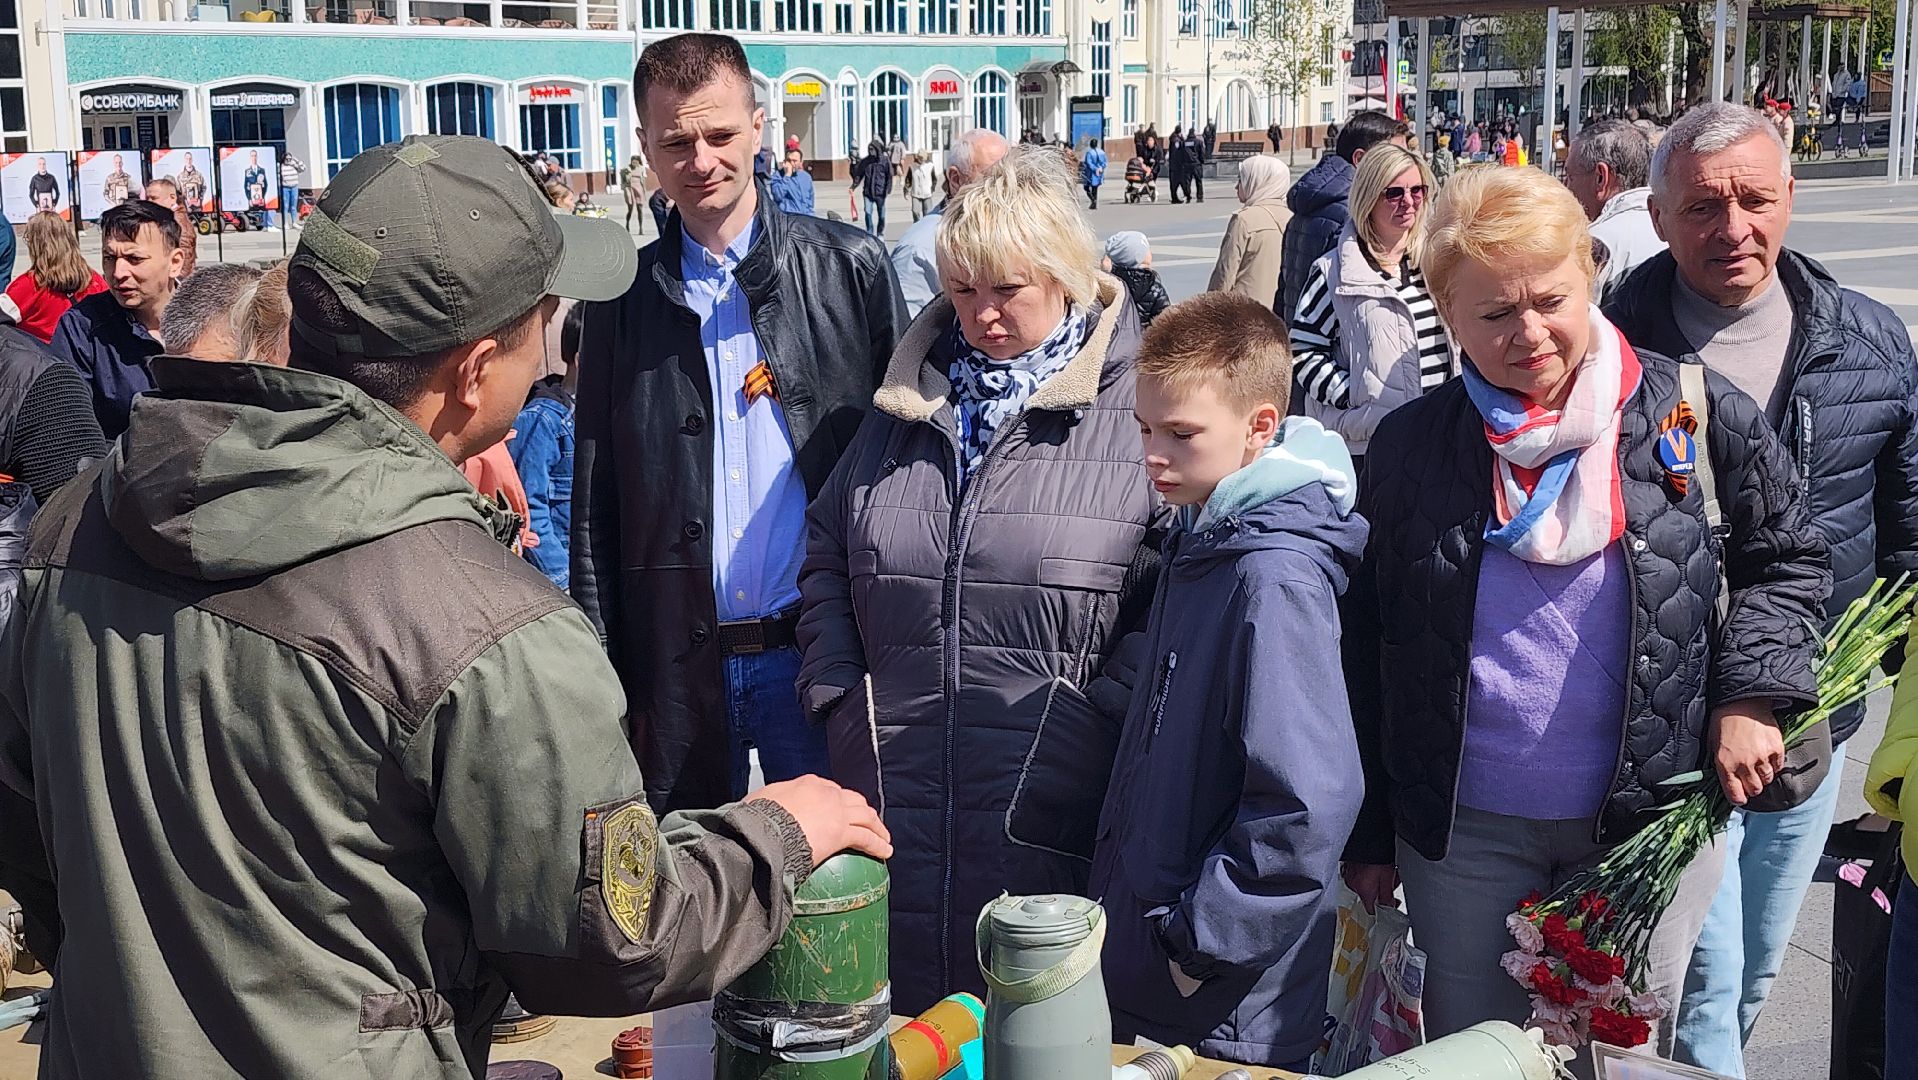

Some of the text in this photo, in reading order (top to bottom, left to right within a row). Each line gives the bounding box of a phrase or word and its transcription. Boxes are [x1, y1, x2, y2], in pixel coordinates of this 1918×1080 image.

[93, 94, 179, 109] СОВКОМБАНК
[211, 93, 295, 107] ЦВЕТ ДИВАНОВ
[1801, 401, 1813, 463] NORT
